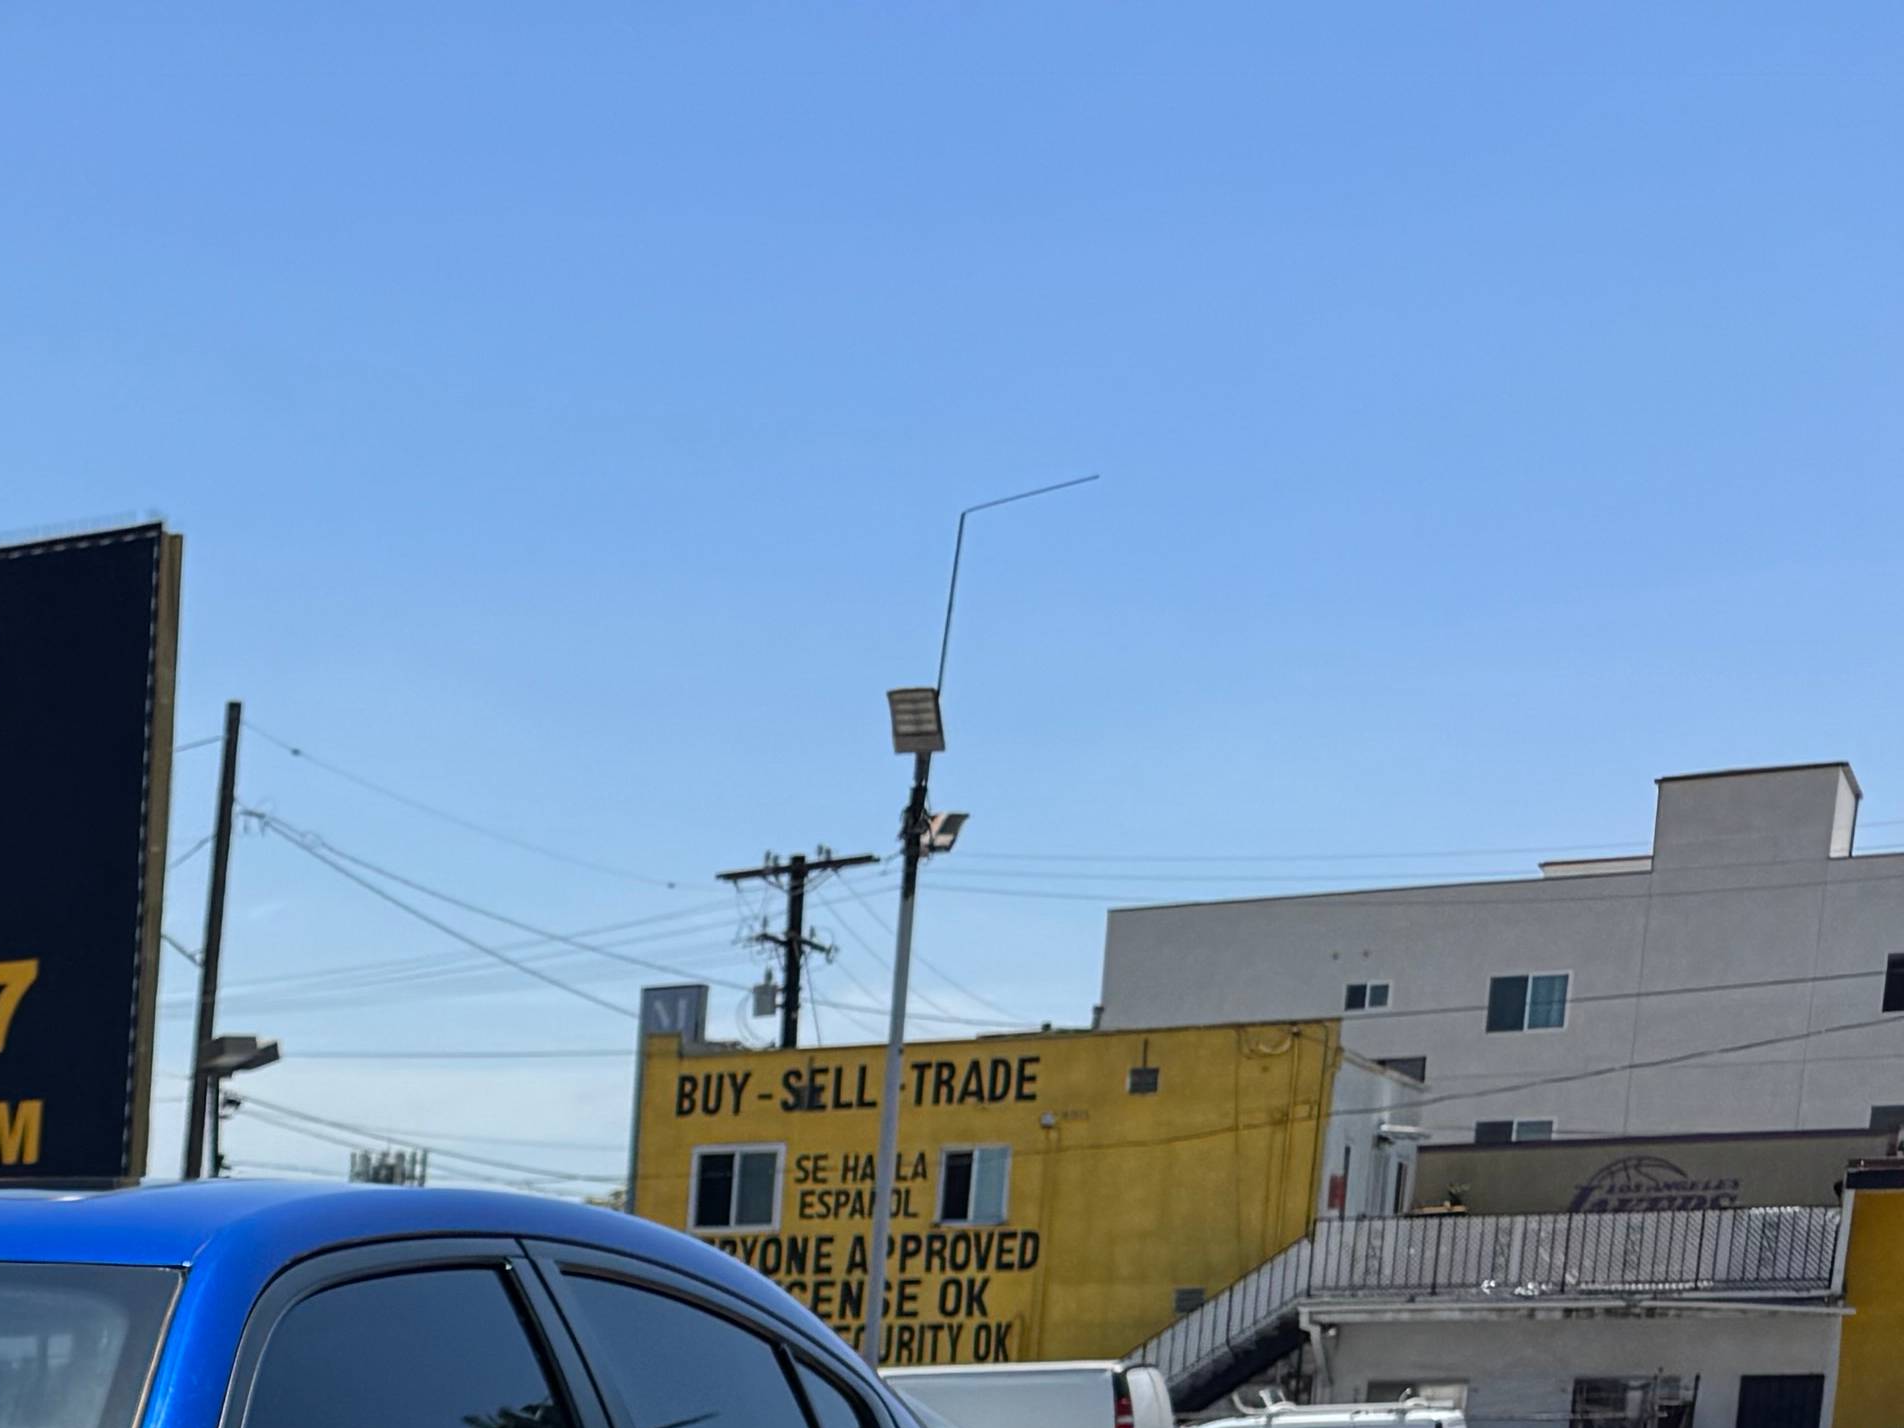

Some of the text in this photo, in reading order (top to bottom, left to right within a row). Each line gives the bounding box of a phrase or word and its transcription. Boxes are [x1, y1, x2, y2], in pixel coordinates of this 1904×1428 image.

[794, 1151, 928, 1184] SE HALA
[938, 1277, 992, 1318] OK
[973, 1322, 1013, 1363] OK
